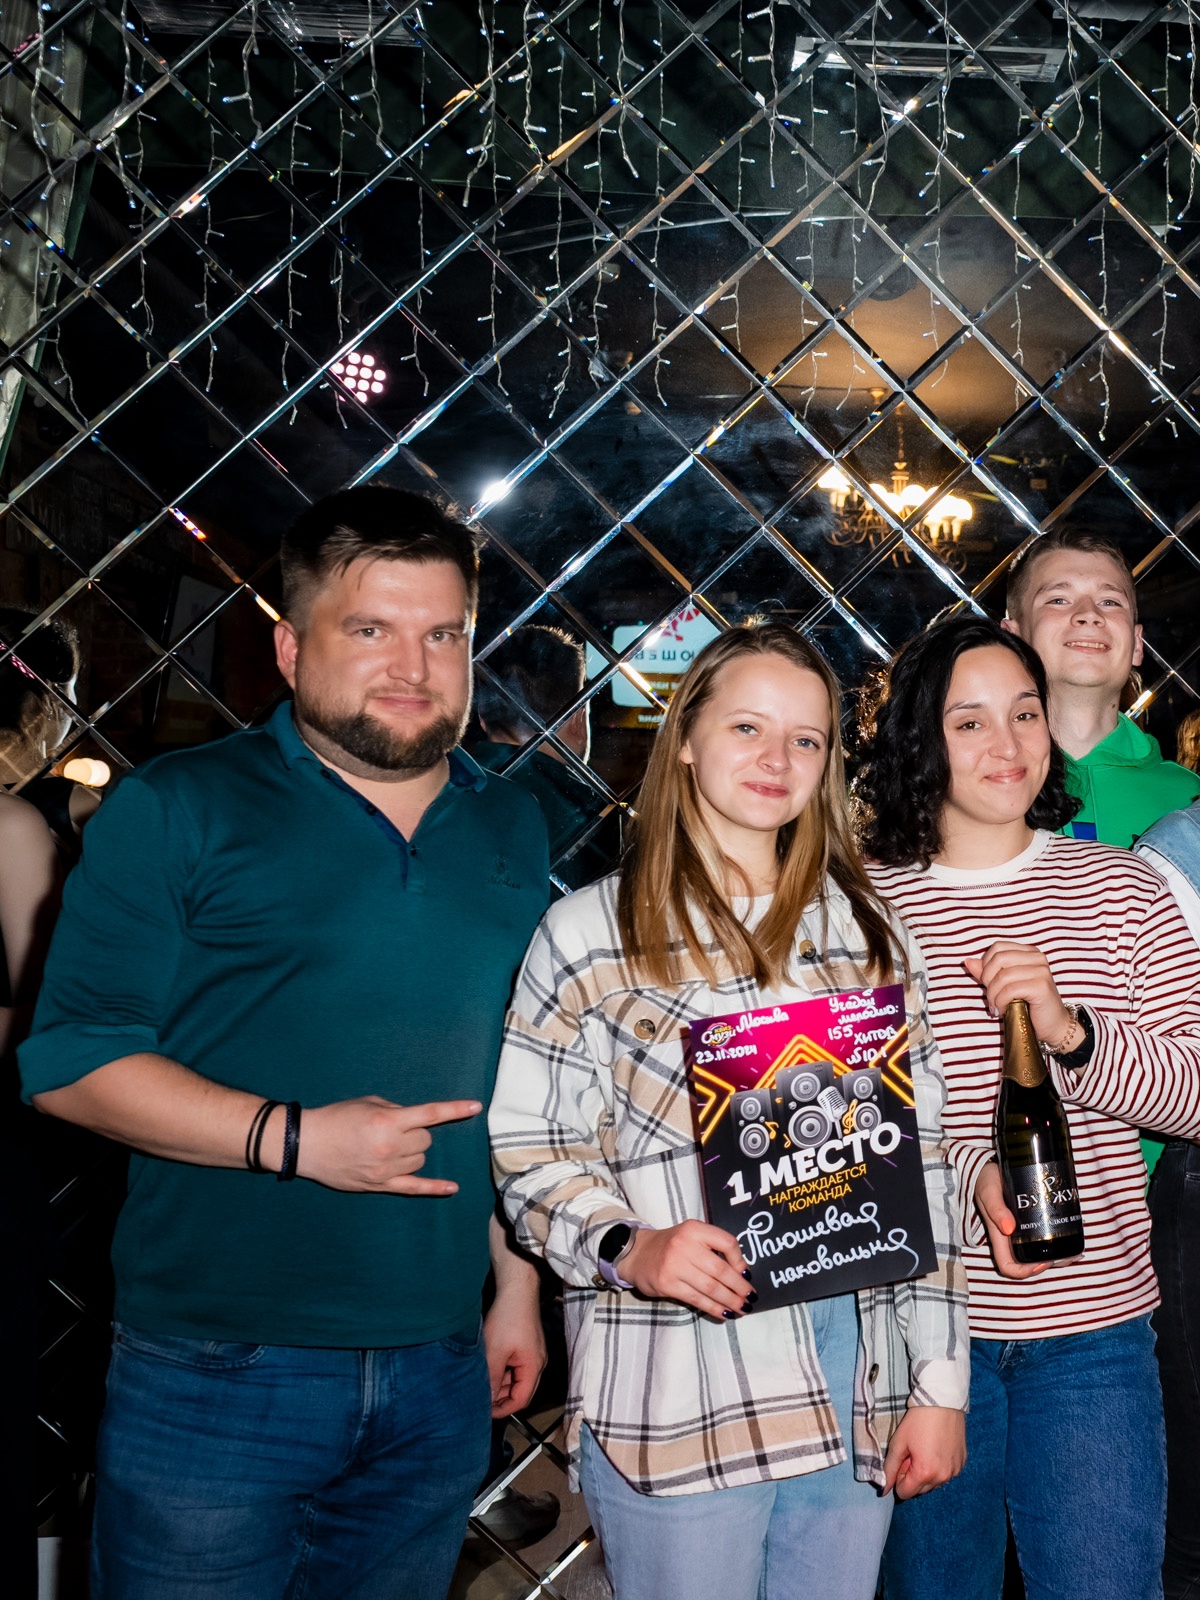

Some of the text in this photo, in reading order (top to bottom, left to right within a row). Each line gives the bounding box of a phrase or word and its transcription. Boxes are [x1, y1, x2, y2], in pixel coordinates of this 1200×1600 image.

[701, 1028, 736, 1044] Смузи
[828, 1024, 853, 1040] 155
[695, 1044, 758, 1064] 23.11.2024
[727, 1121, 901, 1206] 1 МЕСТО
[769, 1163, 867, 1206] НАГРАЖДАЕТСЯ
[788, 1183, 852, 1213] КОМАНДА
